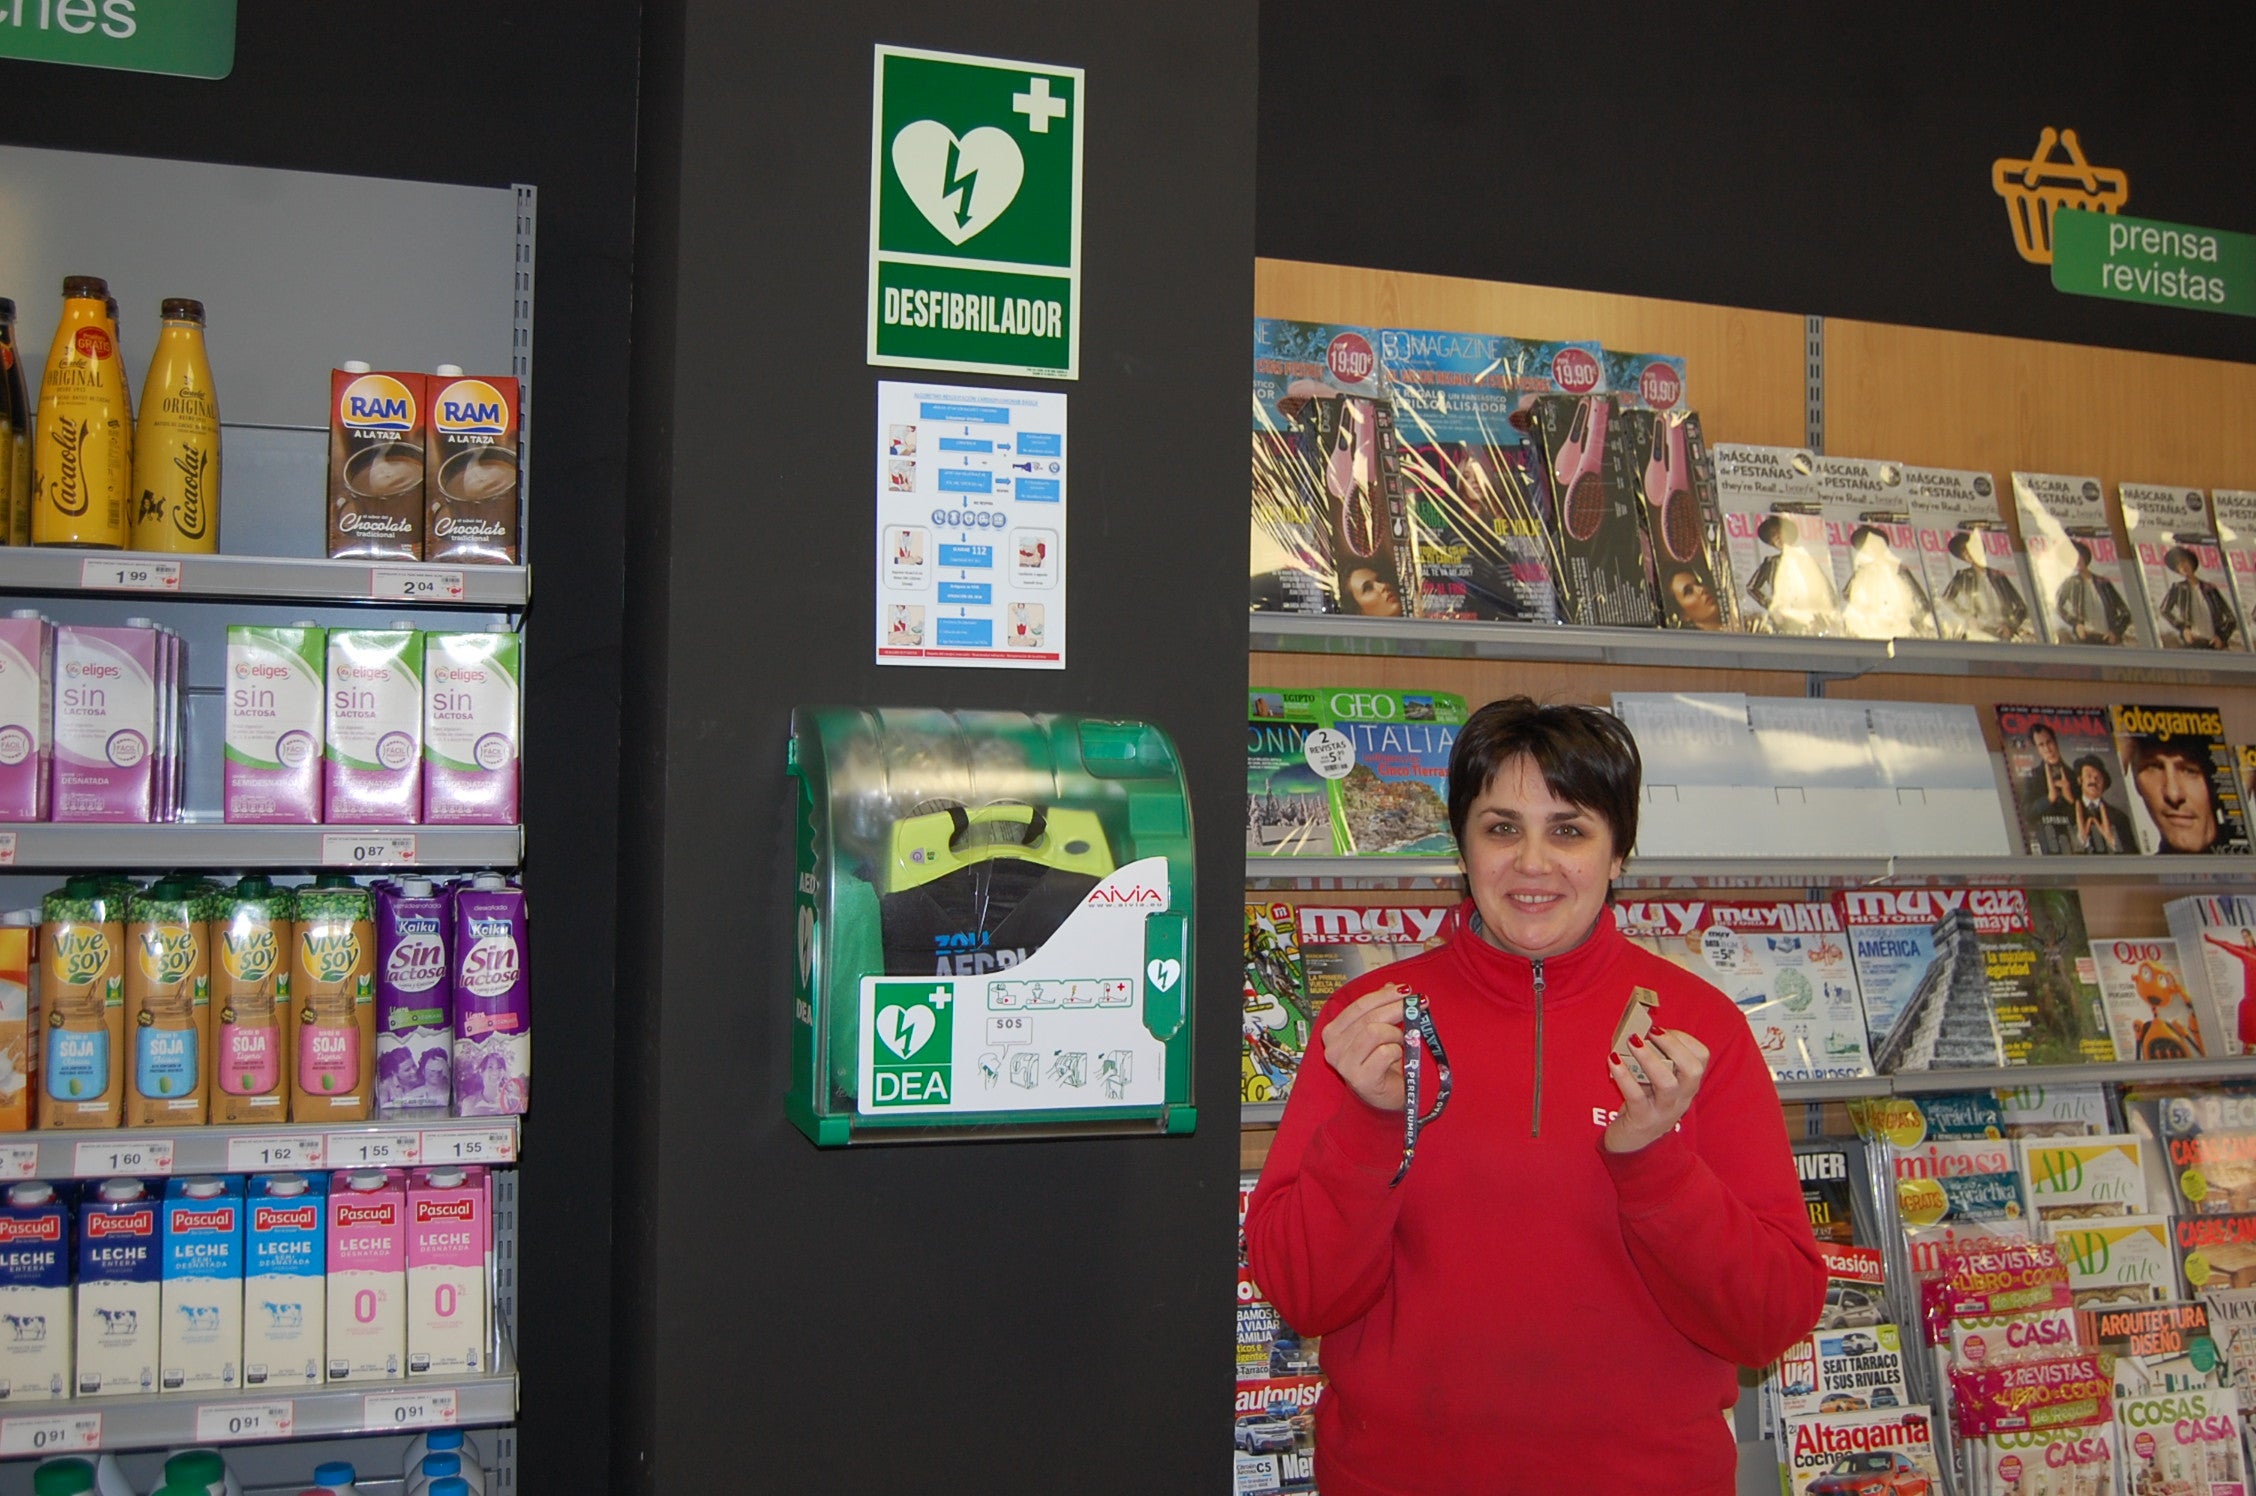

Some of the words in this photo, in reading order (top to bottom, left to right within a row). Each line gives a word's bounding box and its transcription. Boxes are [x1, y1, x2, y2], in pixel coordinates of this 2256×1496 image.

[2109, 222, 2218, 263] prensa
[2103, 262, 2226, 304] revistas
[884, 286, 1063, 339] DESFIBRILADOR
[47, 370, 104, 389] ORIGINAL
[163, 397, 217, 419] ORIGINAL
[350, 397, 407, 419] RAM
[444, 402, 500, 423] RAM
[1446, 400, 1507, 413] ALISADOR
[354, 430, 362, 439] A
[363, 431, 375, 440] LA
[376, 431, 402, 441] TAZA
[448, 435, 456, 443] A
[456, 435, 469, 443] LA
[470, 436, 495, 444] TAZA
[51, 414, 90, 517] Cacaolat
[1719, 450, 1779, 467] MÁSCARA
[1732, 464, 1794, 482] PESTAÑAS
[1905, 473, 1960, 487] MÁSCARA
[173, 442, 209, 540] Cacaolat
[1824, 477, 1884, 493] PESTAÑAS
[1918, 487, 1974, 501] PESTAÑAS
[2123, 488, 2173, 502] MÁSCARA
[2135, 500, 2186, 515] PESTAÑAS
[340, 512, 412, 533] Chocolate
[434, 517, 506, 537] Chocolate
[356, 531, 396, 539] tradicional
[451, 534, 490, 542] tradicional
[972, 546, 987, 556] 112
[82, 664, 119, 679] eliges
[251, 665, 289, 678] eliges
[352, 667, 390, 681] eliges
[449, 669, 486, 682] eliges
[63, 684, 105, 707] sin
[233, 685, 275, 708] sin
[335, 687, 375, 709] sin
[432, 689, 473, 711] sin
[1283, 694, 1316, 703] EGIPTO
[64, 707, 107, 717] LACTOSA
[233, 709, 276, 718] LACTOSA
[335, 710, 376, 719] LACTOSA
[1330, 693, 1396, 719] GEO
[432, 712, 474, 721] LACTOSA
[2111, 704, 2223, 742] Fotogramas
[1319, 731, 1330, 744] 2
[1349, 724, 1456, 754] ITALIA
[1309, 741, 1347, 754] REVISTAS
[1378, 763, 1411, 777] Cinco
[61, 776, 110, 785] DESNATADA
[1845, 889, 1968, 918] muy
[1969, 888, 2028, 916] caza
[399, 920, 436, 933] Kaiku
[1299, 908, 1448, 943] muy
[1712, 906, 1781, 926] muy
[1777, 903, 1842, 933] DATA
[1850, 914, 1938, 924] HISTORIA
[1974, 914, 2030, 934] mayor
[472, 922, 509, 935] Kaiku
[53, 930, 104, 957] Vive
[140, 930, 192, 957] Vive
[223, 930, 274, 956] Vive
[302, 930, 355, 957] Vive
[1302, 933, 1415, 944] HISTORIA
[1858, 936, 1921, 958] AMÉRICA
[69, 948, 109, 975] soy
[157, 948, 197, 975] soy
[239, 948, 279, 974] soy
[320, 949, 359, 974] soy
[390, 942, 440, 970] Sin
[465, 946, 514, 973] Sin
[2113, 941, 2162, 966] Quo
[386, 965, 446, 983] lactosa
[459, 968, 520, 989] lactosa
[1309, 980, 1331, 988] VUELTA
[1309, 986, 1335, 994] MUNDO
[796, 998, 814, 1027] DEA
[996, 1018, 1023, 1029] SOS
[61, 1039, 94, 1057] SOJA
[150, 1038, 184, 1055] SOJA
[232, 1036, 266, 1053] SOJA
[313, 1036, 346, 1053] SOJA
[876, 1071, 948, 1102] DEA
[1407, 1072, 1416, 1105] PEREZ
[1793, 1153, 1847, 1181] IVER
[1893, 1146, 2008, 1180] micasa
[2034, 1150, 2084, 1194] AD
[174, 1212, 229, 1226] Pascual
[259, 1210, 312, 1225] Pascual
[340, 1207, 392, 1221] Pascual
[419, 1203, 470, 1217] Pascual
[0, 1219, 55, 1237] Pascual
[92, 1216, 148, 1230] Pascual
[419, 1233, 471, 1246] LECHE
[2177, 1219, 2224, 1248] CASAS
[174, 1243, 229, 1258] LECHE
[258, 1241, 312, 1256] LECHE
[340, 1237, 391, 1251] LECHE
[420, 1244, 470, 1252] DESNATADA
[0, 1251, 55, 1266] LECHE
[92, 1246, 147, 1261] LECHE
[340, 1249, 391, 1258] DESNATADA
[1956, 1257, 1969, 1275] 2
[1969, 1249, 2055, 1274] REVISTAS
[2069, 1231, 2110, 1276] AD
[9, 1265, 45, 1273] ENTERA
[101, 1260, 137, 1268] ENTERA
[175, 1260, 227, 1269] DESNATADA
[258, 1258, 311, 1268] DESNATADA
[1245, 1319, 1281, 1332] VIAJAR
[2100, 1305, 2208, 1337] ARQUITECTURA
[2006, 1318, 2073, 1349] CASA
[2130, 1331, 2182, 1357] DISEÑO
[1822, 1358, 1847, 1376] SEAT
[1847, 1353, 1899, 1373] TARRACO
[1823, 1375, 1833, 1391] Y
[1833, 1373, 1854, 1391] SUS
[1855, 1368, 1901, 1388] RIVALES
[2001, 1370, 2014, 1388] 2
[2015, 1361, 2095, 1387] REVISTAS
[2127, 1394, 2207, 1428] COSAS
[2173, 1414, 2237, 1446] CASA
[2044, 1437, 2111, 1469] CASA
[1256, 1461, 1272, 1474] C5
